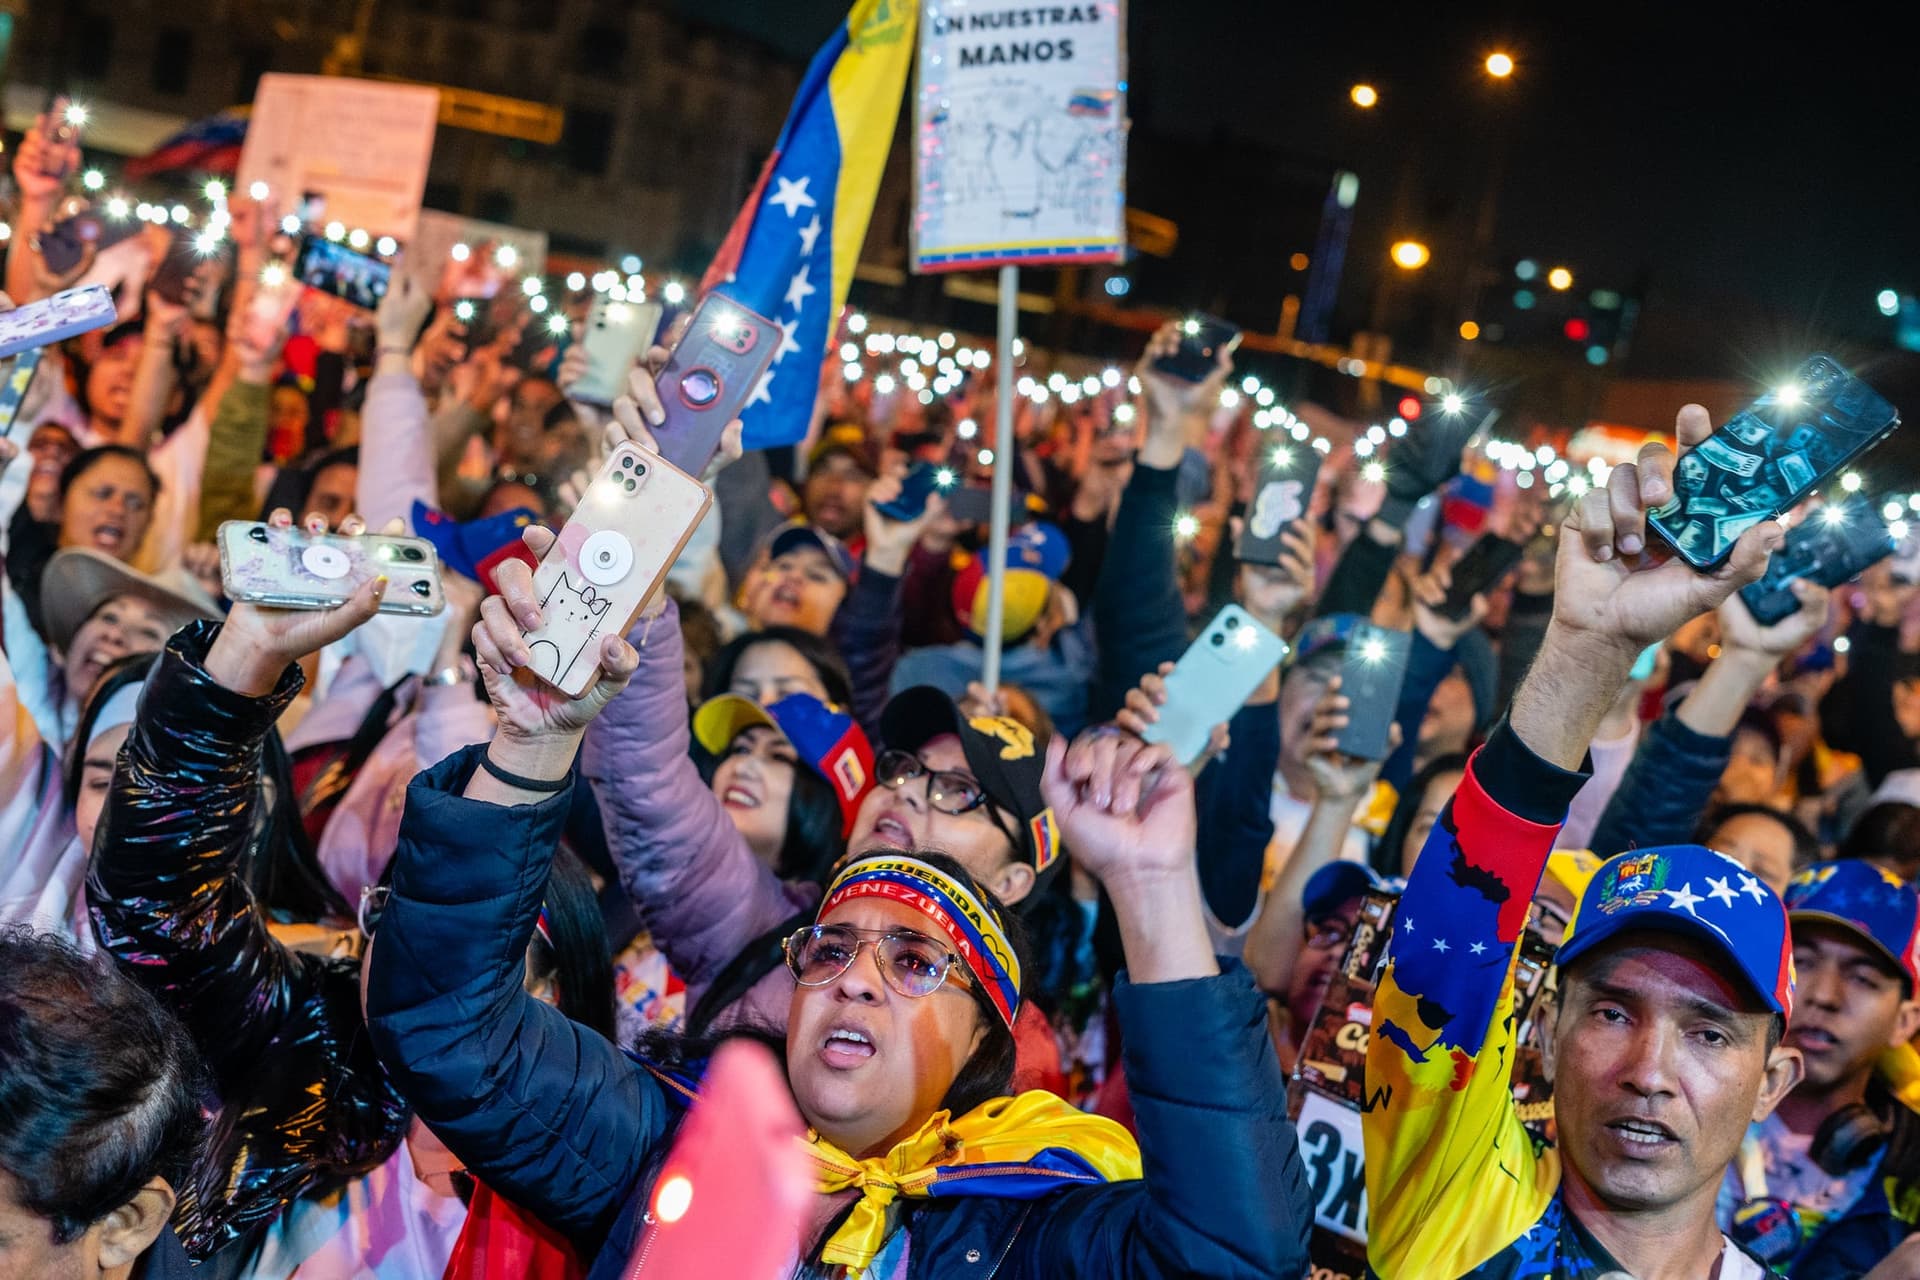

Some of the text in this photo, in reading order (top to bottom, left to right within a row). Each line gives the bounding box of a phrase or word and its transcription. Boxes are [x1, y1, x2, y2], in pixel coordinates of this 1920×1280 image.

[969, 4, 1100, 31] NUESTRAS
[959, 38, 1075, 68] MANOS
[875, 862, 983, 930] QUERIDA
[831, 883, 972, 959] VENEZUELA
